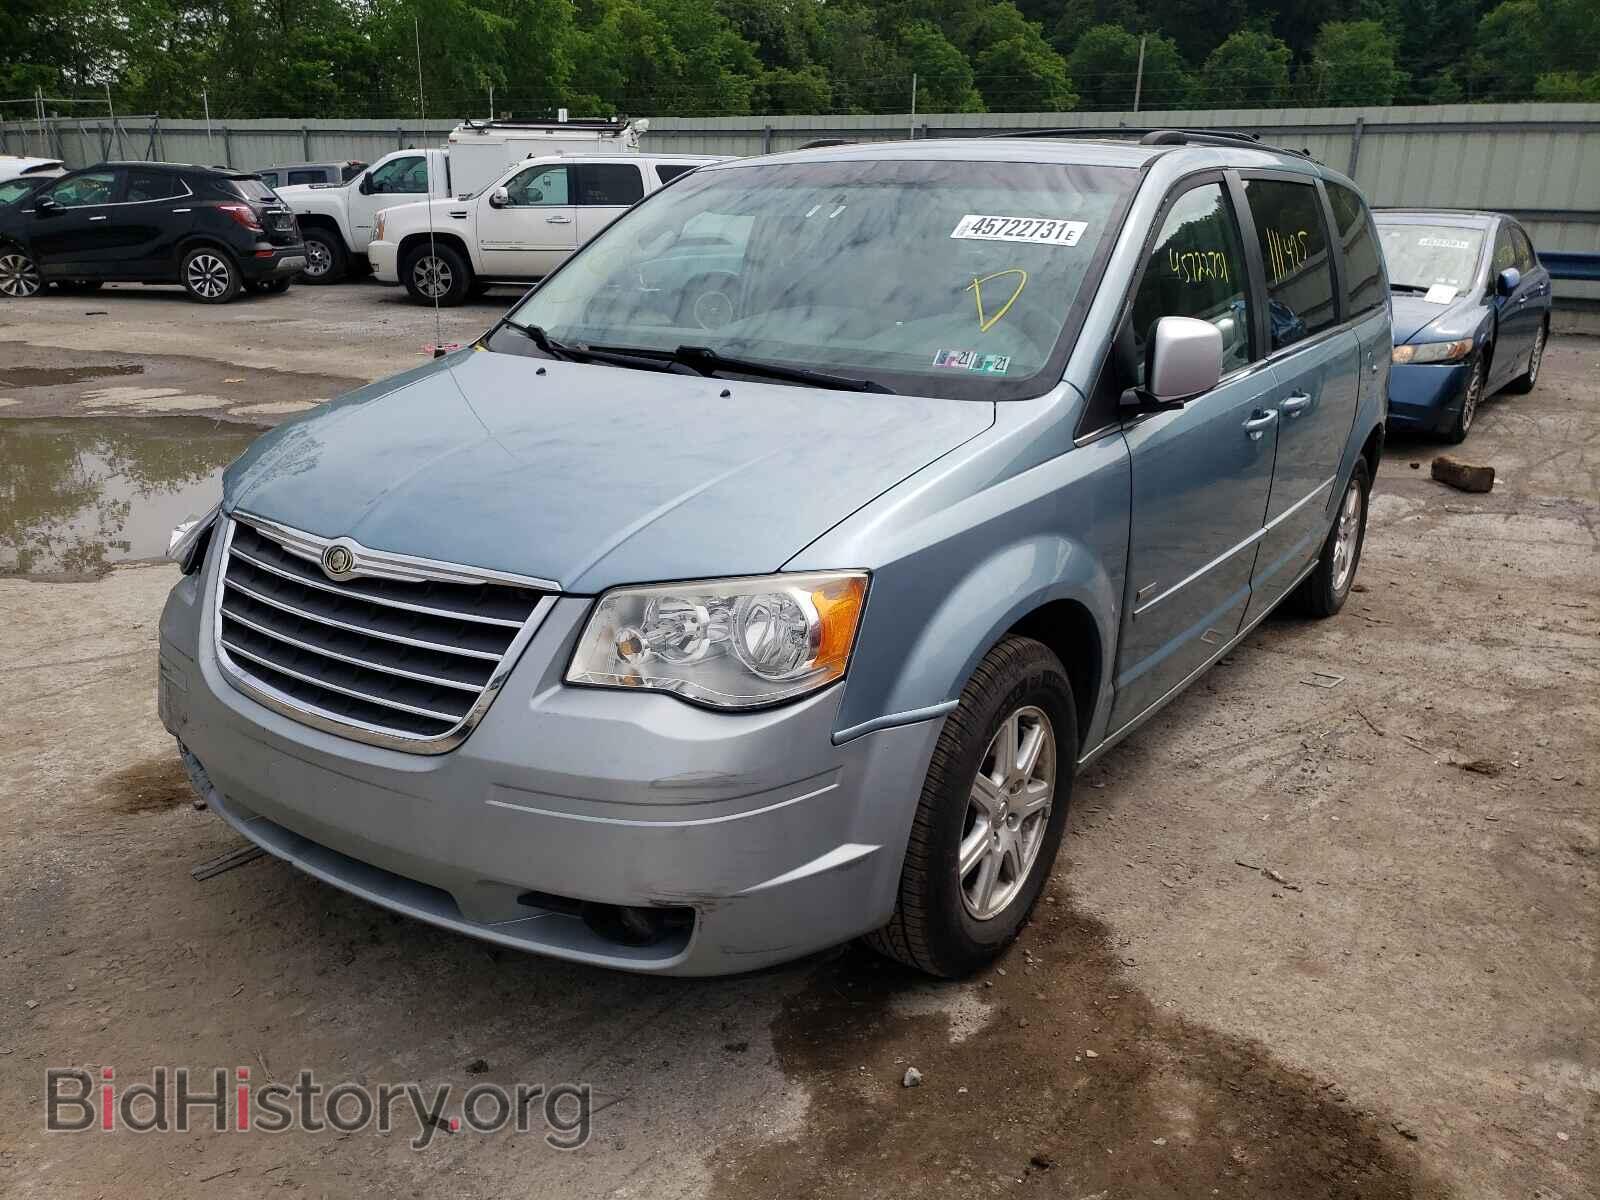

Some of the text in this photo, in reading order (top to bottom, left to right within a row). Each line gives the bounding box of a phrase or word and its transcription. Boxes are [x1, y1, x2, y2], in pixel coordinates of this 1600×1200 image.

[970, 217, 1067, 240] 45722731
[1169, 247, 1230, 284] 45722731
[958, 351, 971, 365] 21
[995, 356, 1007, 371] 21
